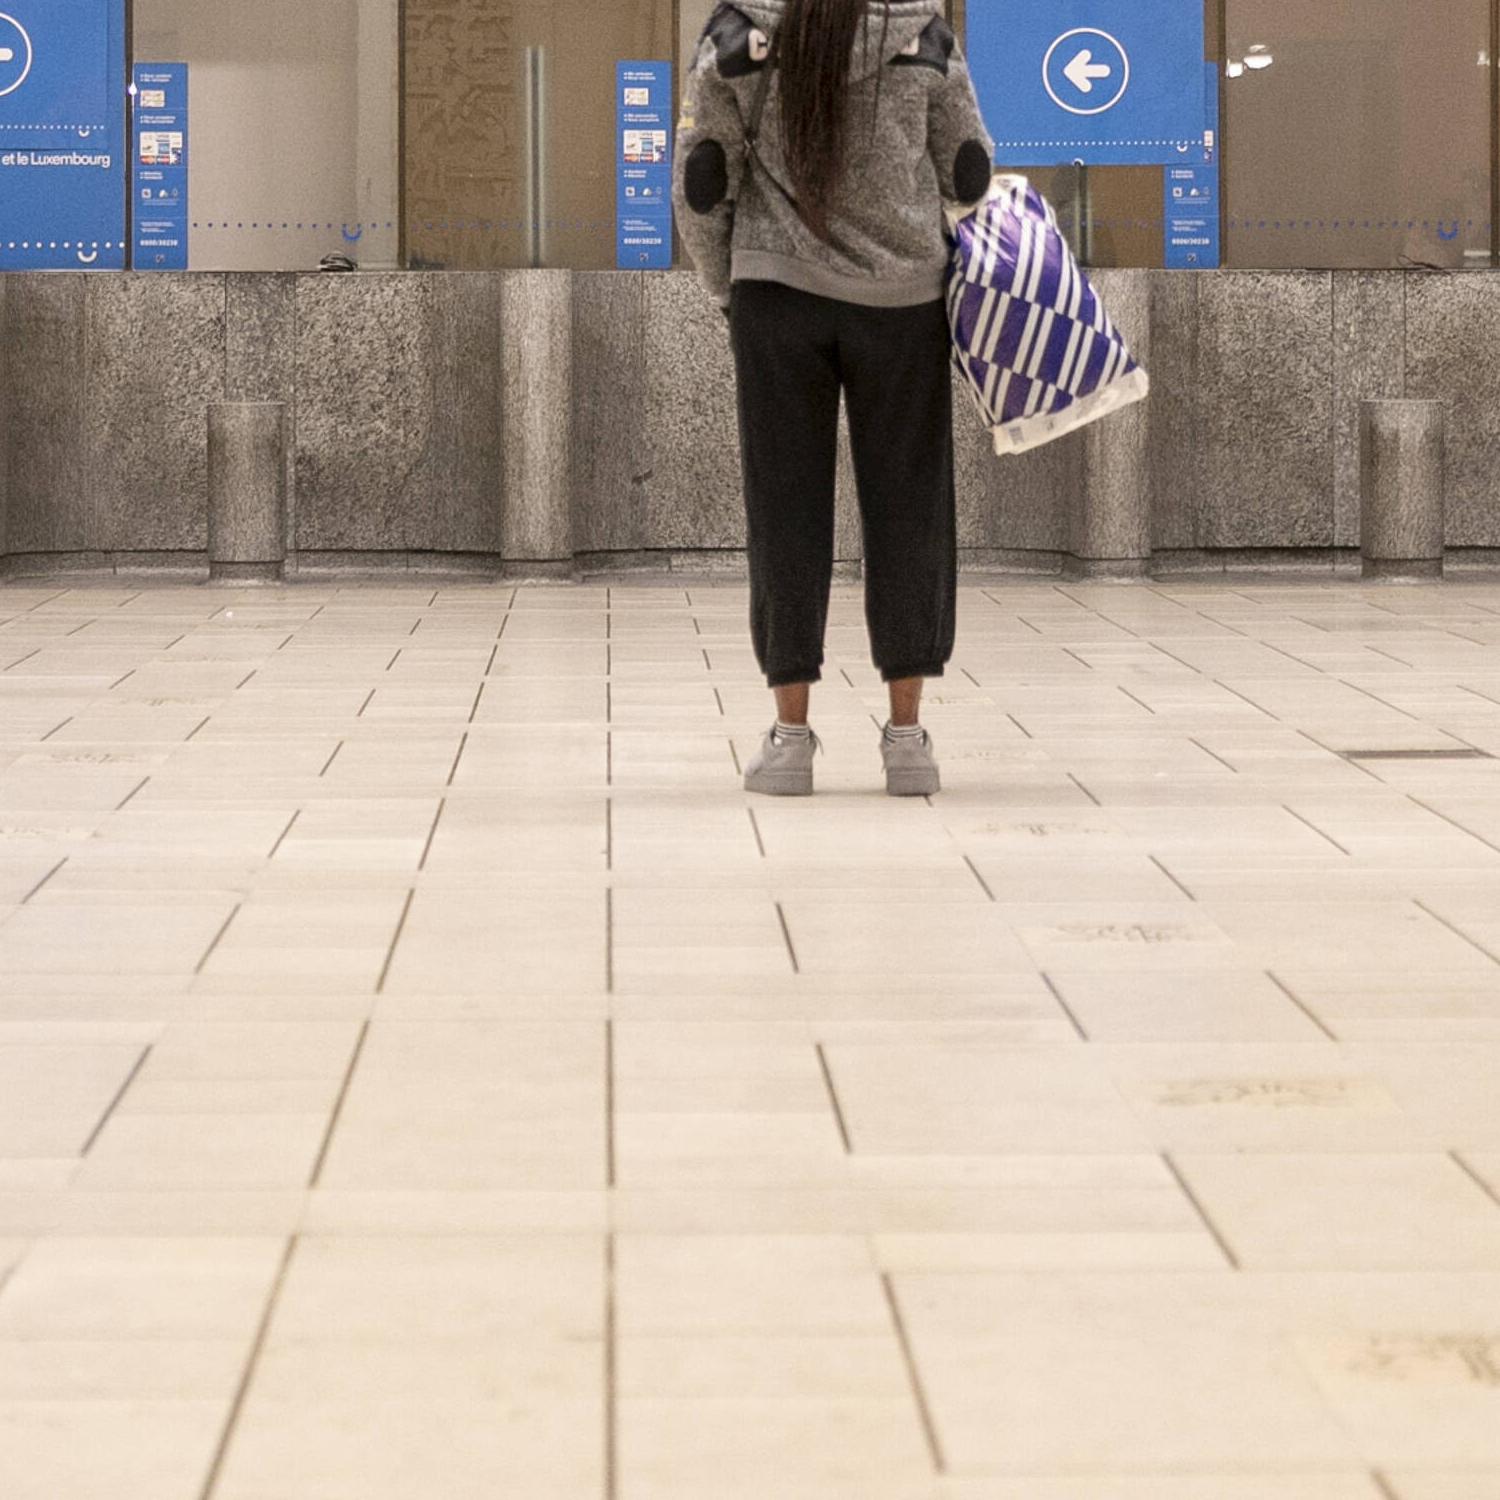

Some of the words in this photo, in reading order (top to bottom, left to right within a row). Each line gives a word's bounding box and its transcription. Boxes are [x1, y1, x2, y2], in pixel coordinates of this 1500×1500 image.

[2, 153, 15, 166] et
[17, 152, 29, 166] le
[30, 152, 111, 169] Luxembourg
